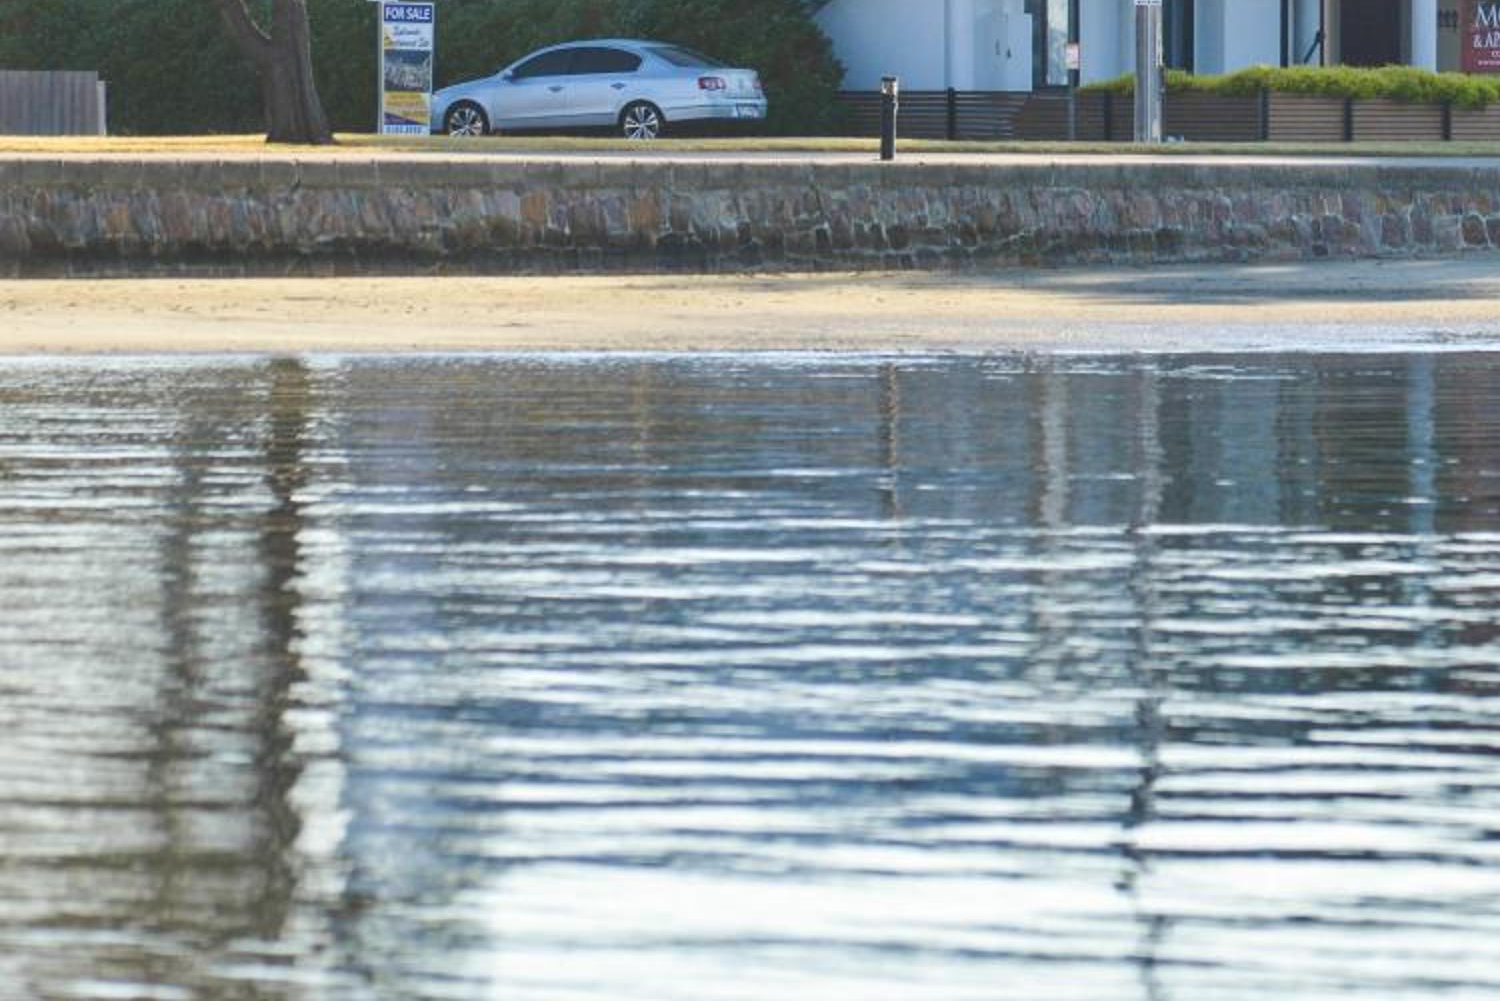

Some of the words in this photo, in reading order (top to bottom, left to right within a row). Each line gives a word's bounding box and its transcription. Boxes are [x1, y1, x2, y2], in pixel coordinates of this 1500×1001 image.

[385, 7, 404, 20] FOR
[406, 7, 431, 20] SALE
[1474, 34, 1482, 49] &
